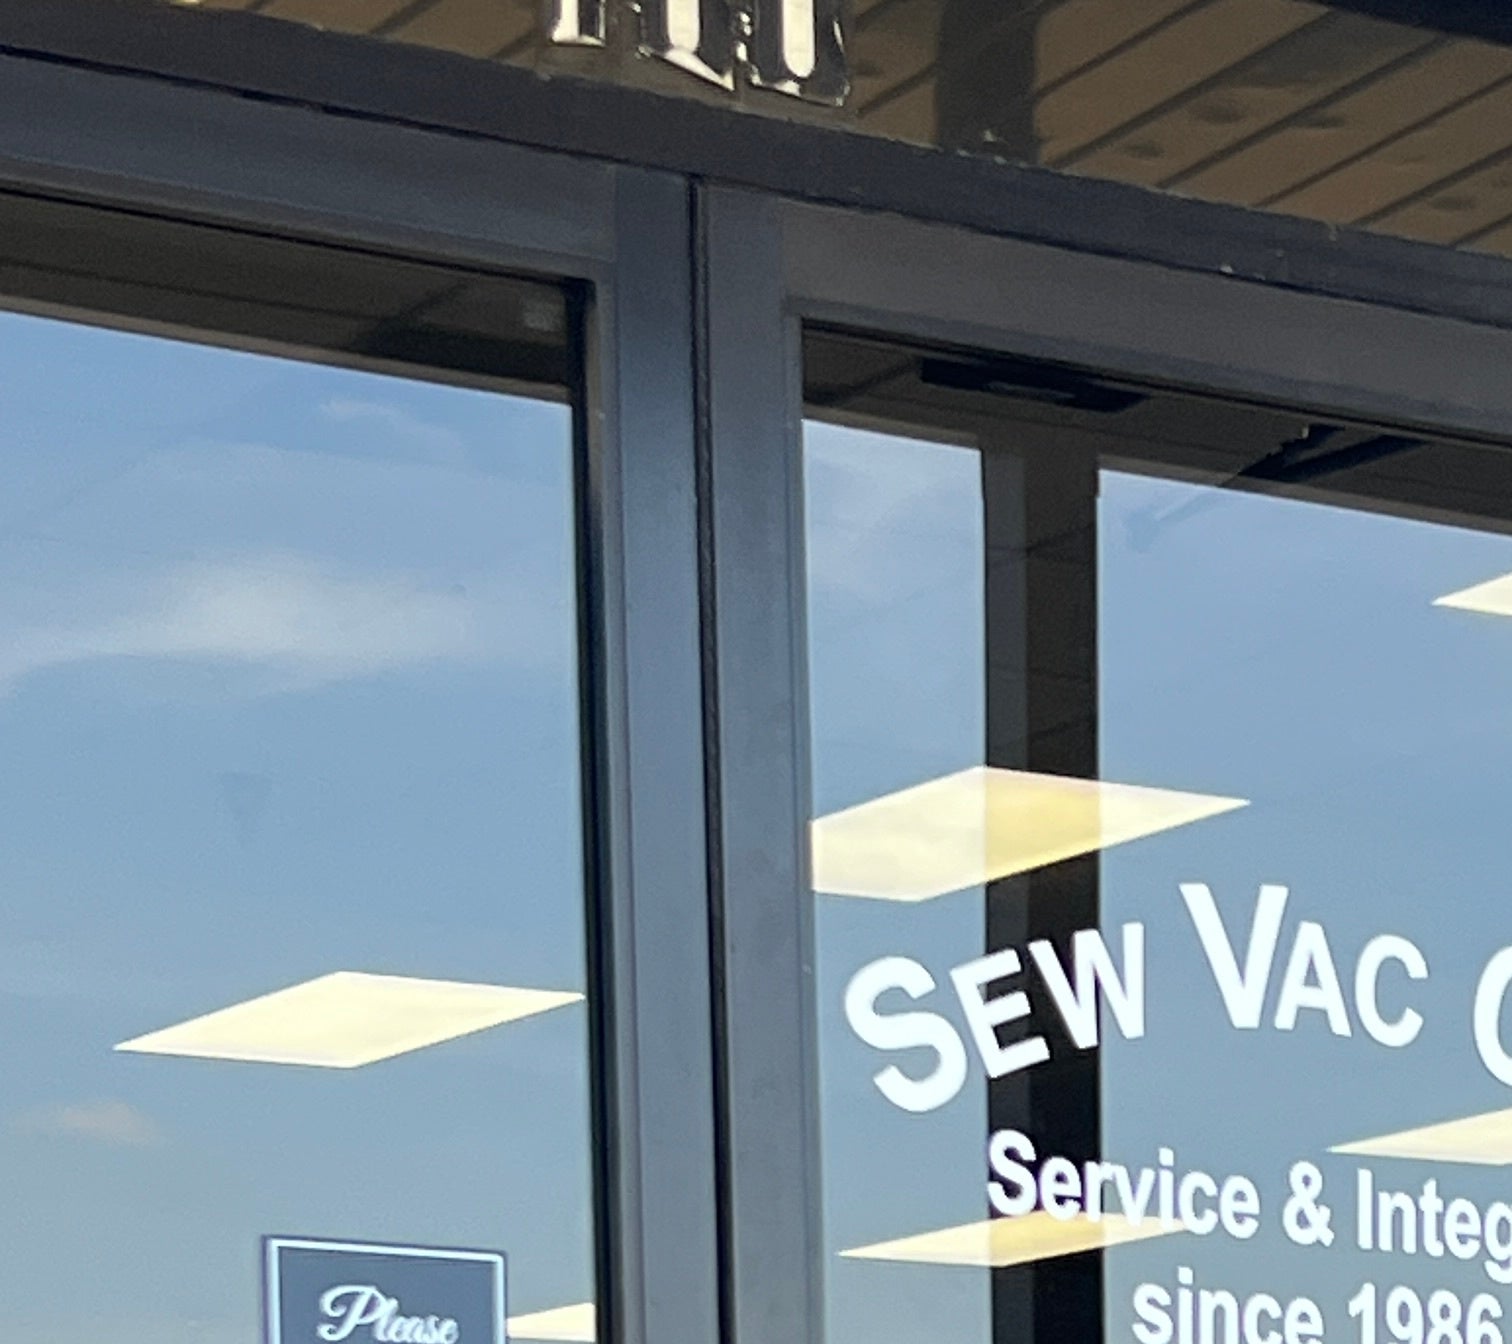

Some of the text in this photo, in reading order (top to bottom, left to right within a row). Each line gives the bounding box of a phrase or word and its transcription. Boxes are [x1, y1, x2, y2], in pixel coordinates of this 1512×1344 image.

[844, 922, 1145, 1113] SEW
[1179, 884, 1430, 1048] VAC
[986, 1130, 1261, 1235] Service
[1282, 1160, 1336, 1249] &
